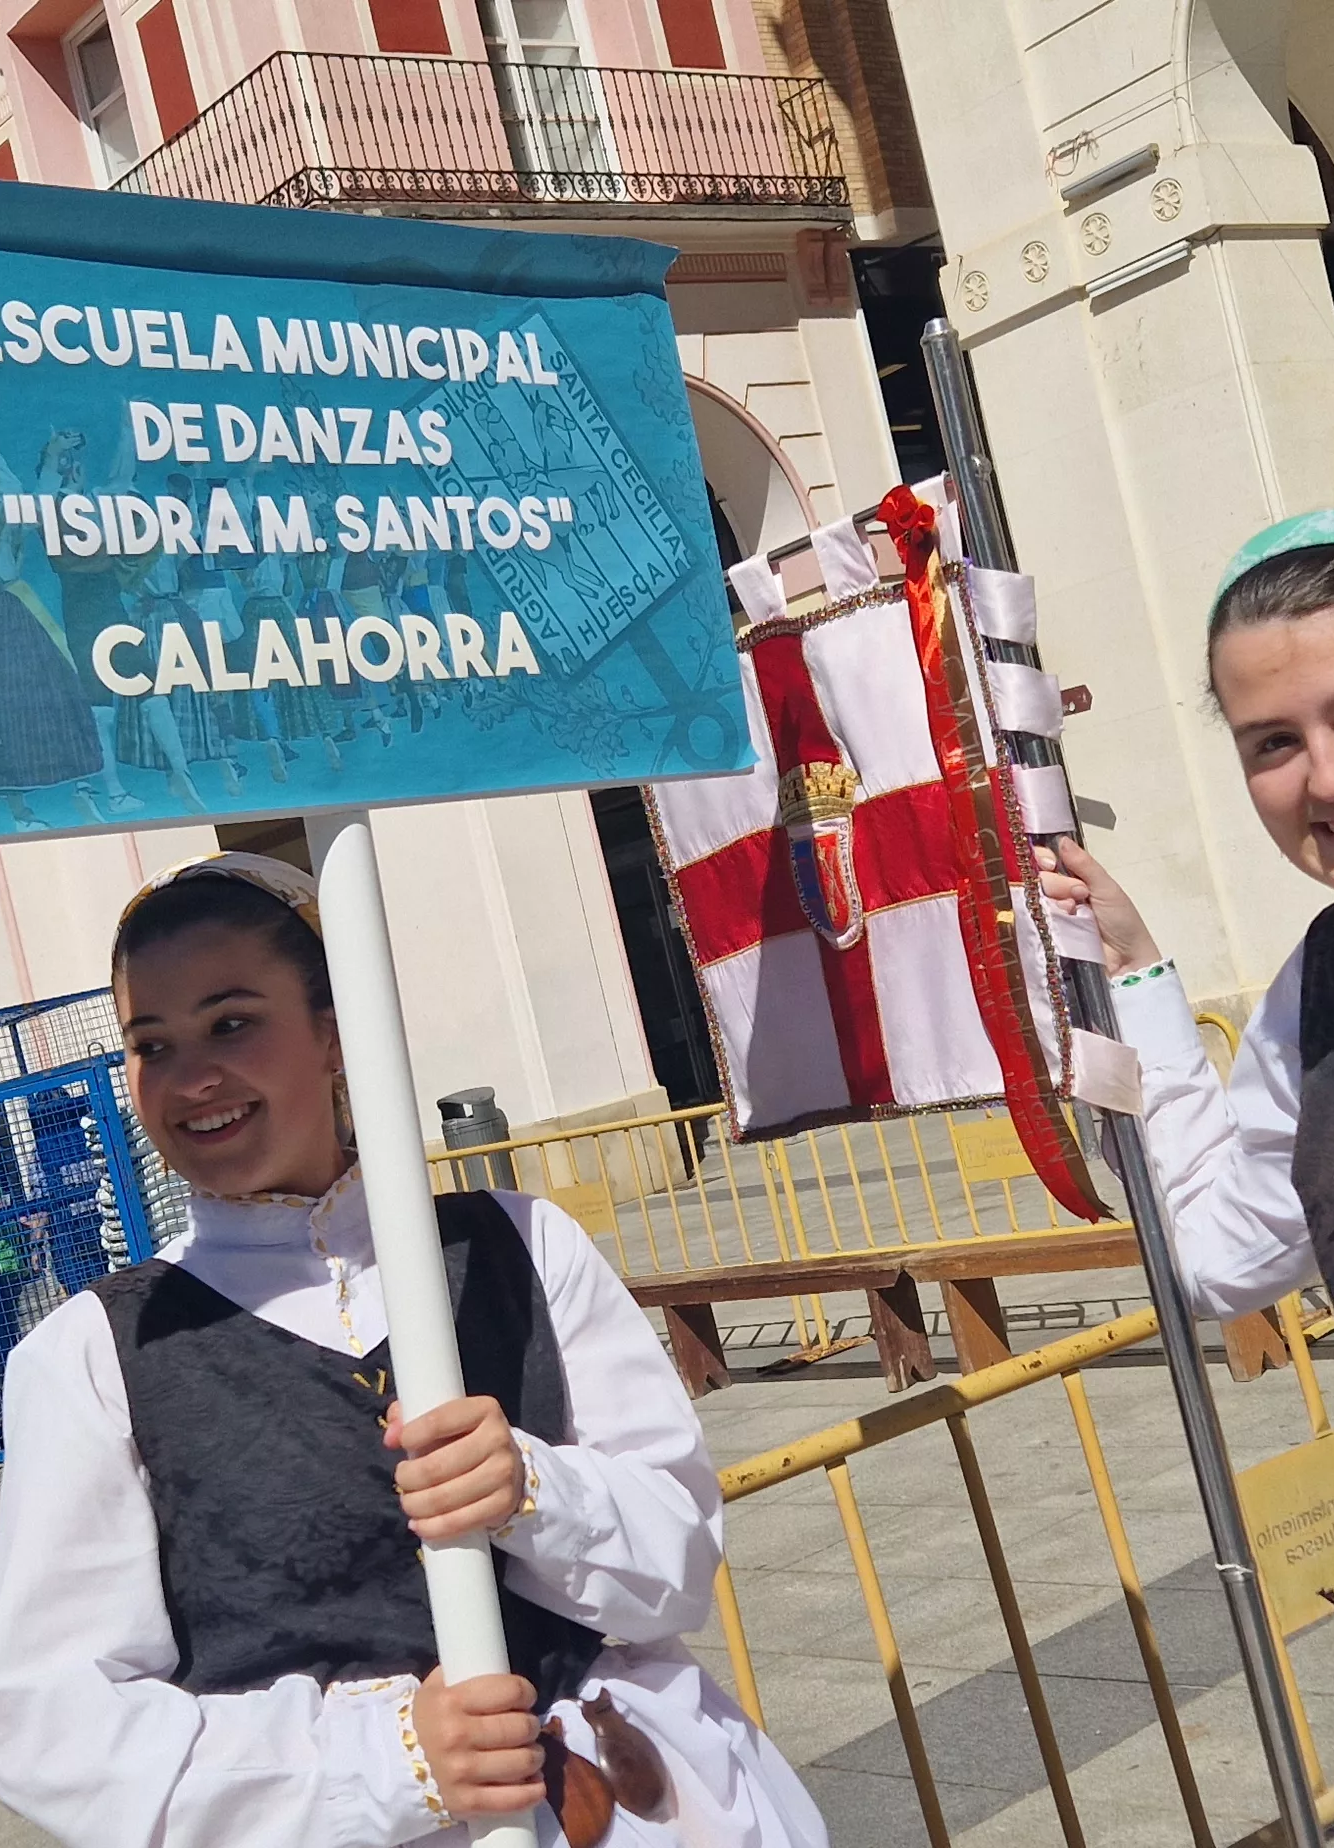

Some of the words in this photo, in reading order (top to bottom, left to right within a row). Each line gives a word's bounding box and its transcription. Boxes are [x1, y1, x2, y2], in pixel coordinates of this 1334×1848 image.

[257, 316, 559, 386] MUNICIPAL
[129, 400, 211, 462] DE
[216, 403, 453, 466] DANZAS
[549, 349, 611, 448] SANTA
[611, 447, 684, 552] CECILIA
[3, 486, 255, 557] "ISIDRA
[257, 495, 329, 554] M.
[334, 494, 573, 553] SANTOS"
[431, 456, 560, 644] AGRUPON
[577, 561, 667, 647] HUESCA
[91, 610, 541, 697] CALAHORRA
[924, 652, 992, 794] NIEVES
